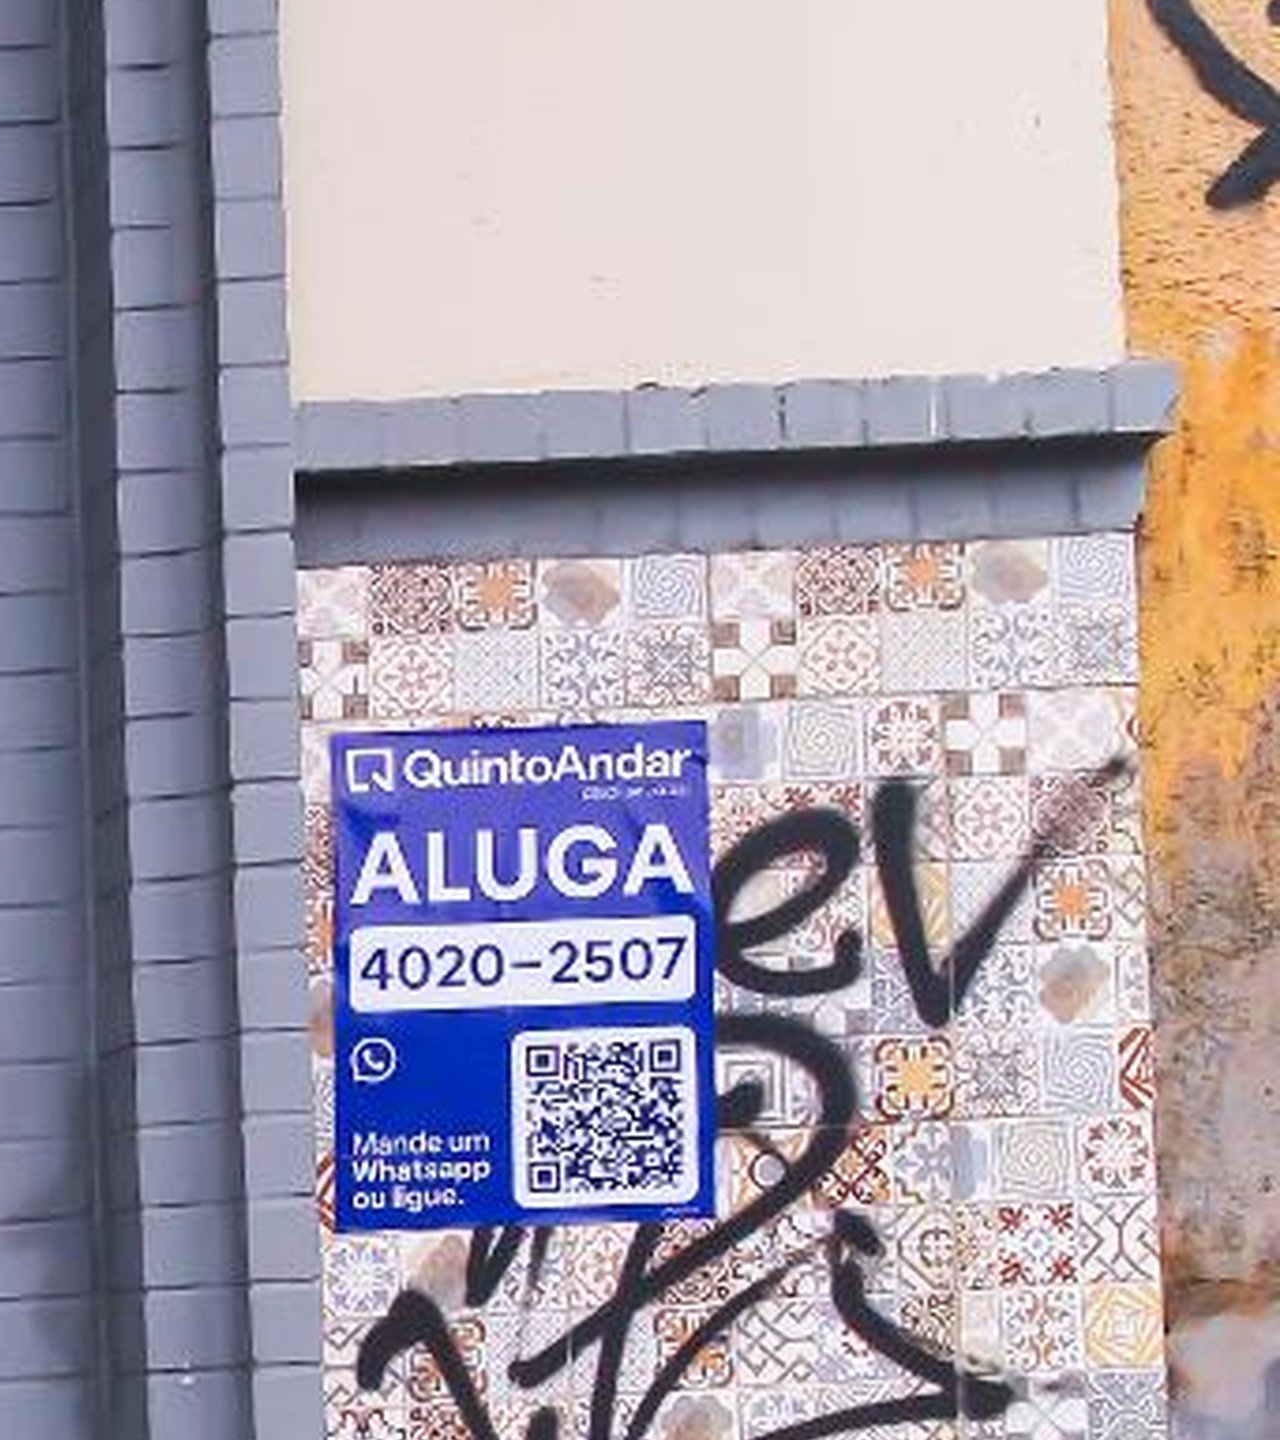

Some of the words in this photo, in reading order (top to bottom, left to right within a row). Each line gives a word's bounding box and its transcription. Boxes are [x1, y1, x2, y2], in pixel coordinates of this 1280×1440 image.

[403, 742, 692, 789] QuintoAndar
[349, 823, 696, 906] ALUGA
[359, 935, 689, 991] 4020-2507
[352, 1130, 443, 1156] Mande
[447, 1133, 489, 1153] um
[352, 1190, 385, 1210] ou
[391, 1185, 464, 1213] ligue.
